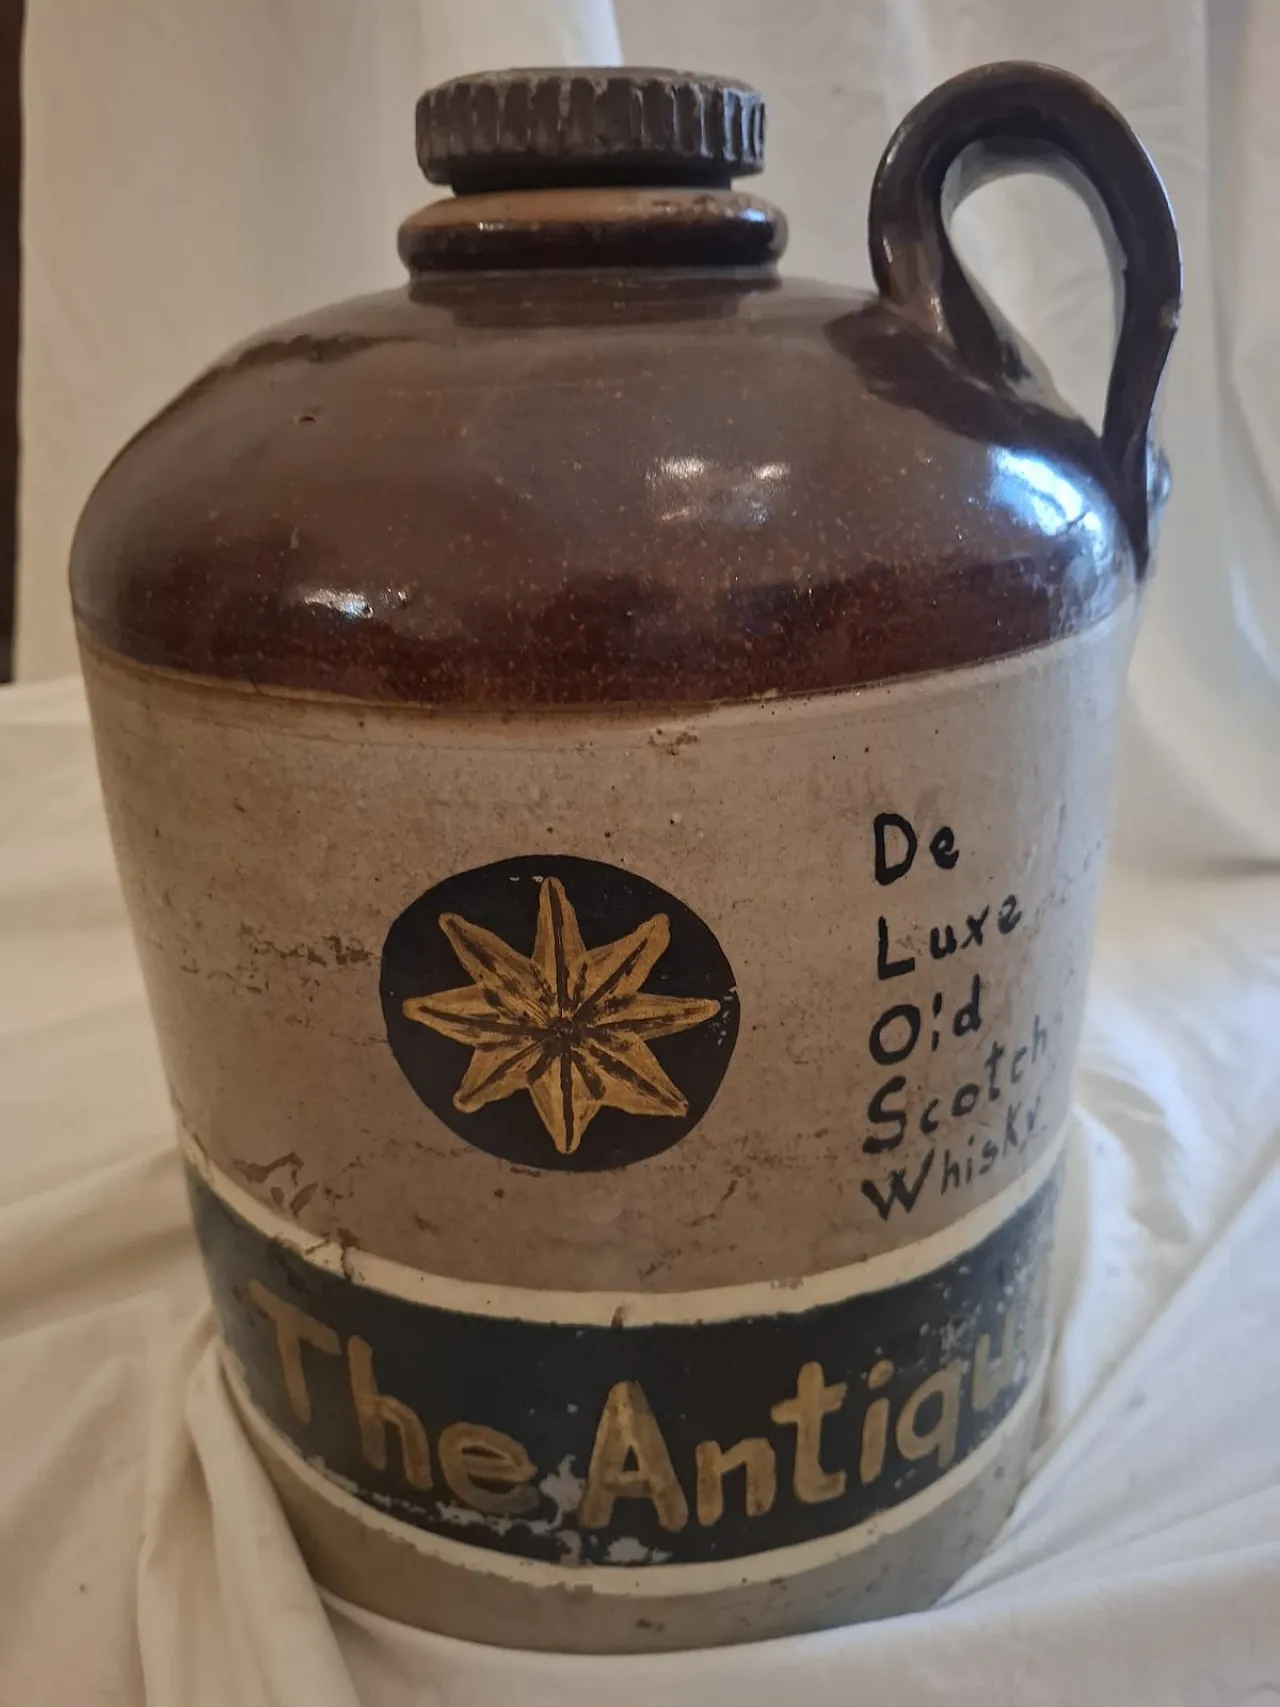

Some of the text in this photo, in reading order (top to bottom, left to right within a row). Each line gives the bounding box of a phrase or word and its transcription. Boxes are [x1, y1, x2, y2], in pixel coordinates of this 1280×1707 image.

[874, 812, 960, 886] De
[877, 894, 1022, 980] Luxe
[868, 973, 982, 1066] Old
[862, 1014, 1049, 1155] Scotch
[247, 1278, 541, 1514] The
